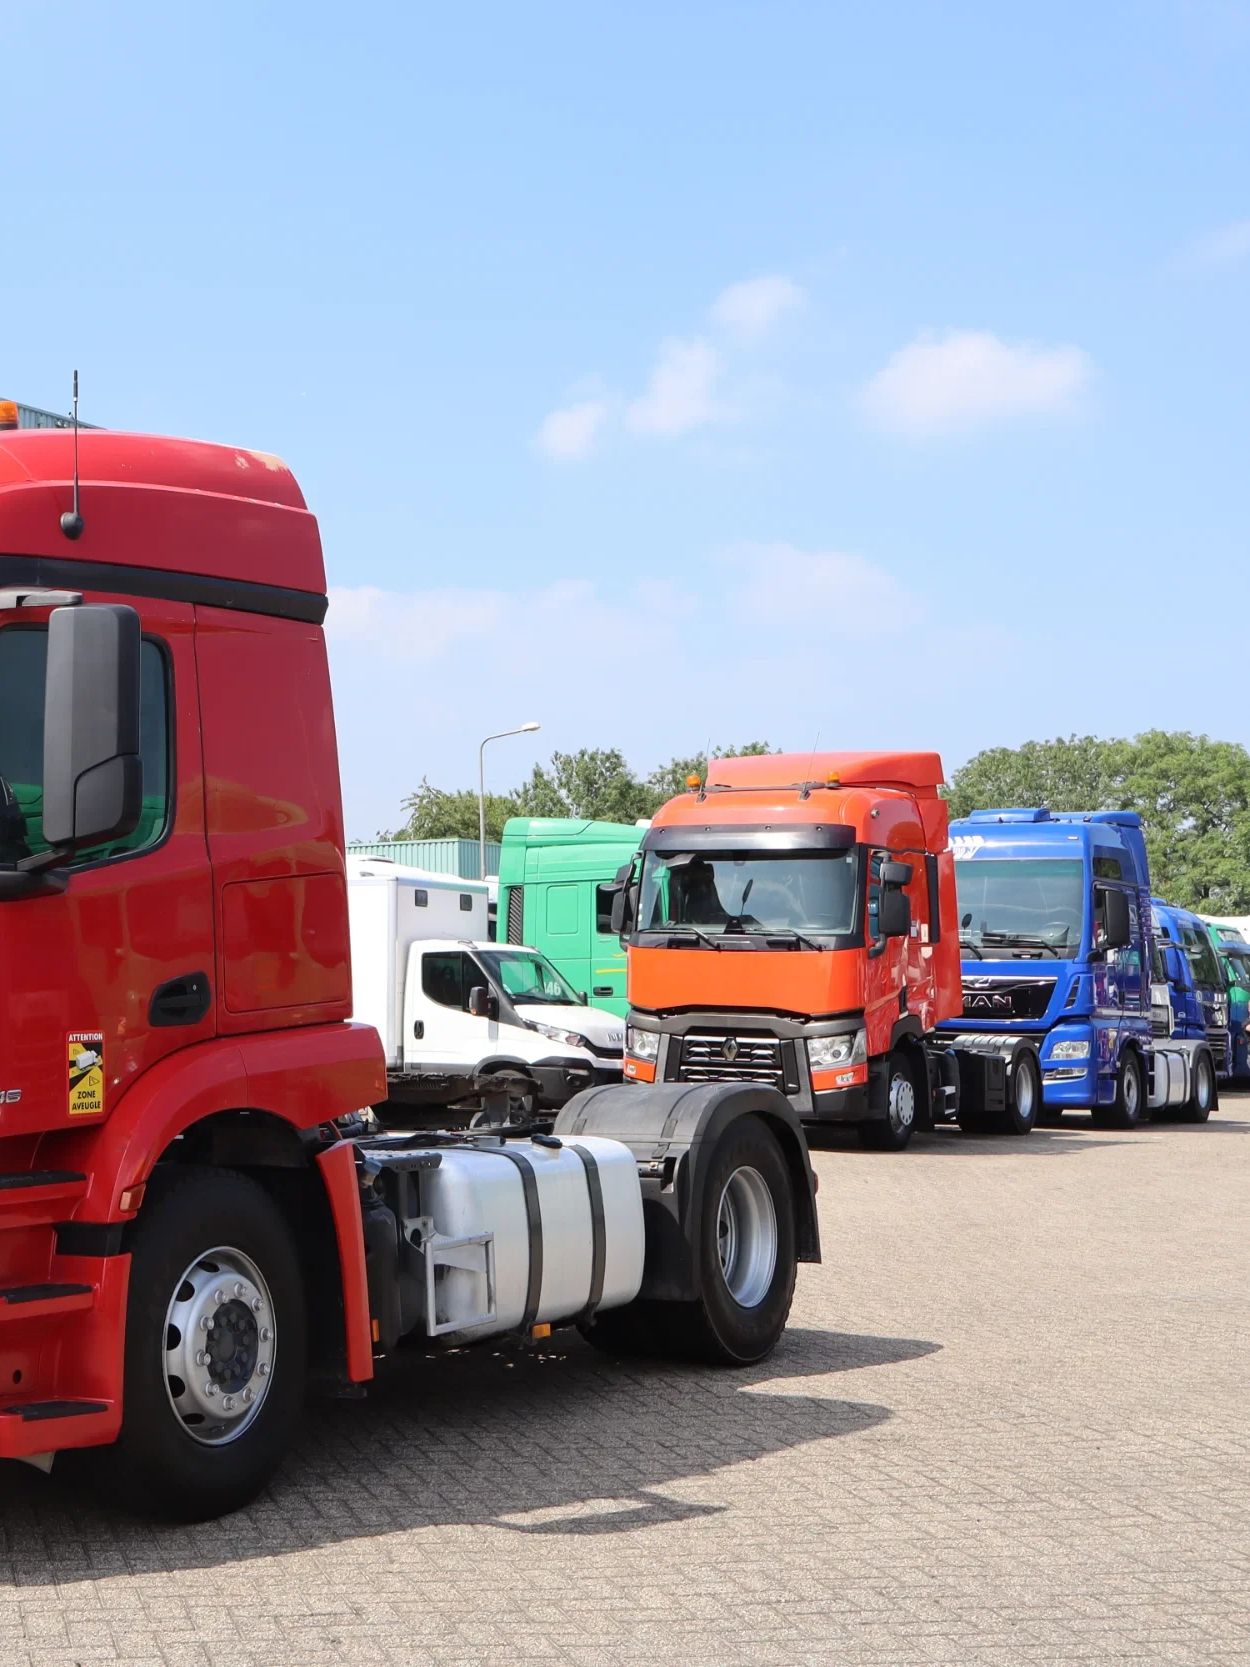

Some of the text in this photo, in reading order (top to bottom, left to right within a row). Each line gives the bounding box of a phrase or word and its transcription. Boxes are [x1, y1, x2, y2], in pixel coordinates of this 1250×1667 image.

[68, 1032, 103, 1042] ATTENTION
[77, 1090, 96, 1099] ZONE
[71, 1101, 101, 1110] AVEUGLE
